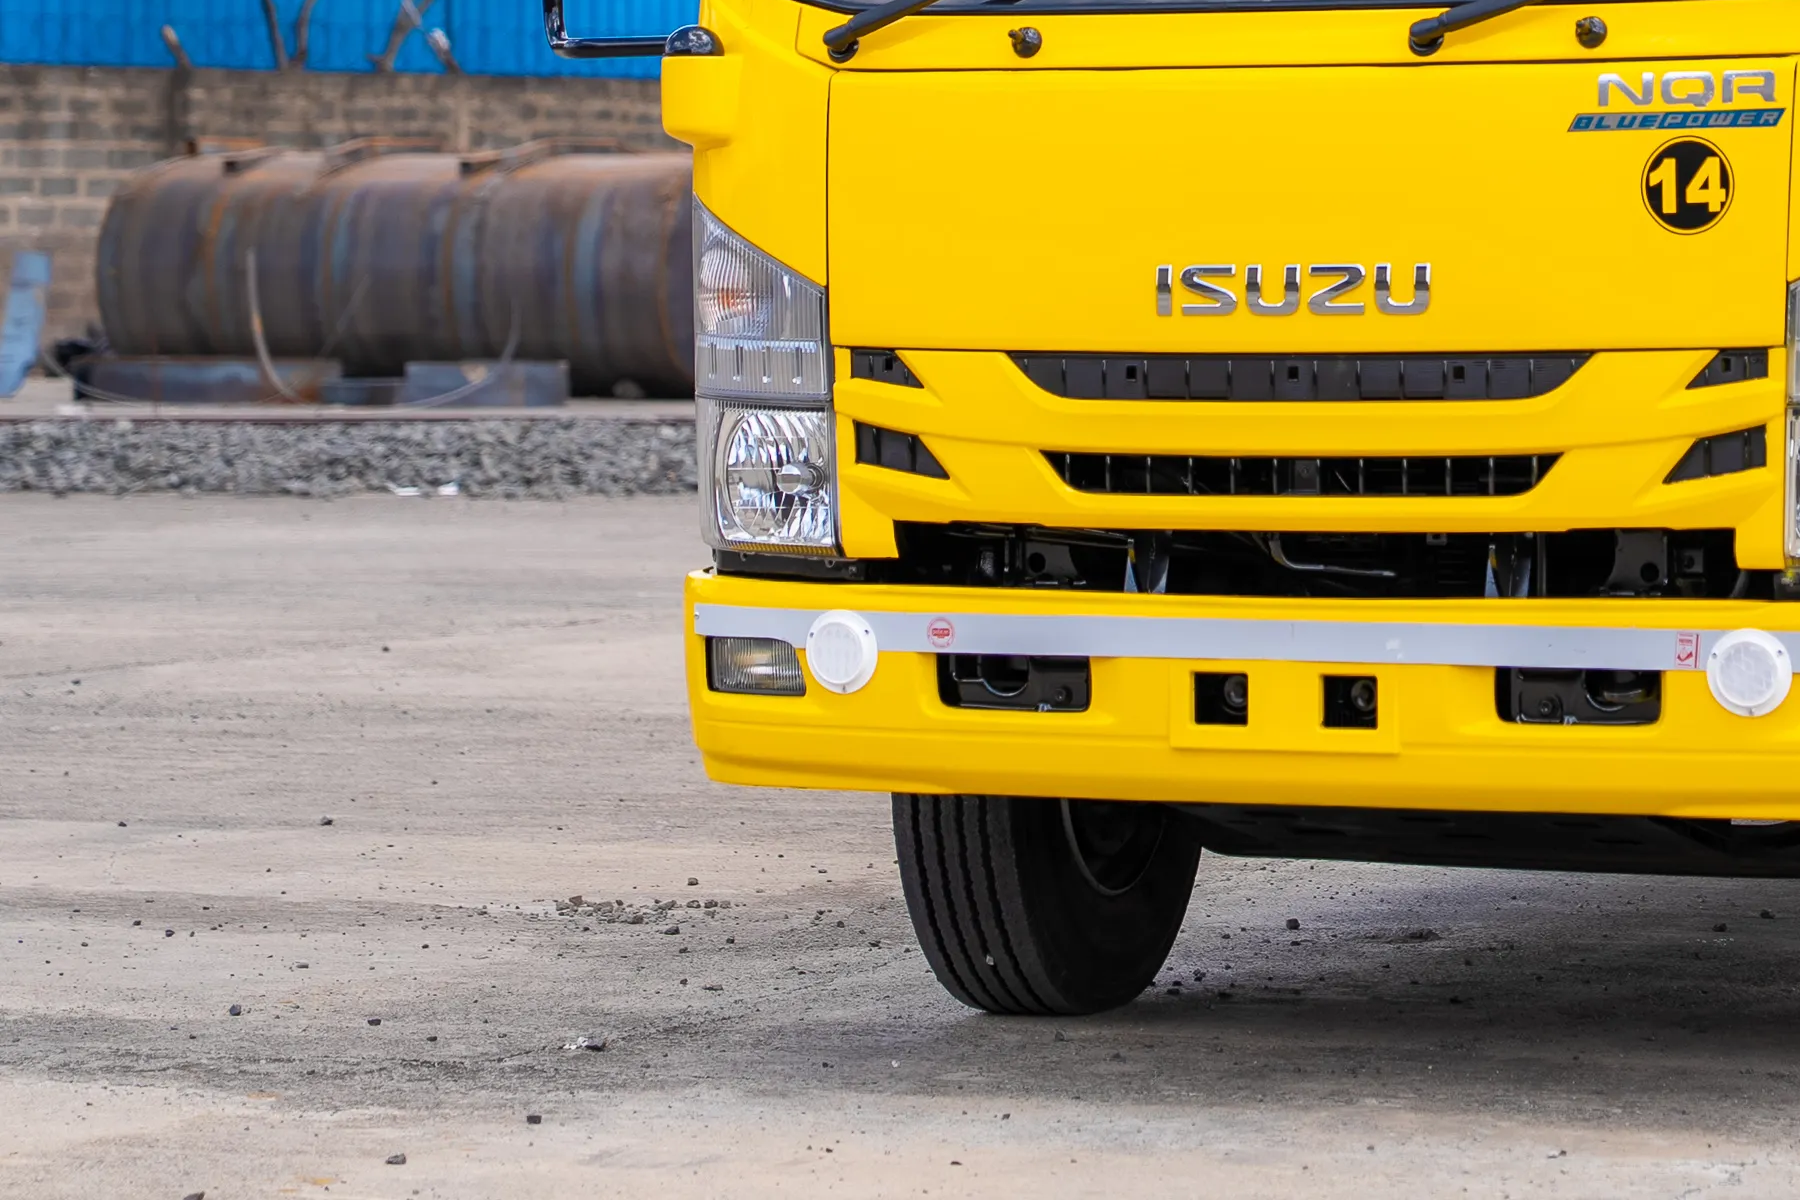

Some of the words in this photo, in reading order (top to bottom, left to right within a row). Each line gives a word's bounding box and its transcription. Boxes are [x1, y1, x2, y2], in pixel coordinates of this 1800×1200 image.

[1597, 70, 1778, 108] NQR
[1648, 156, 1727, 214] 14
[1156, 263, 1431, 316] ISUZU
